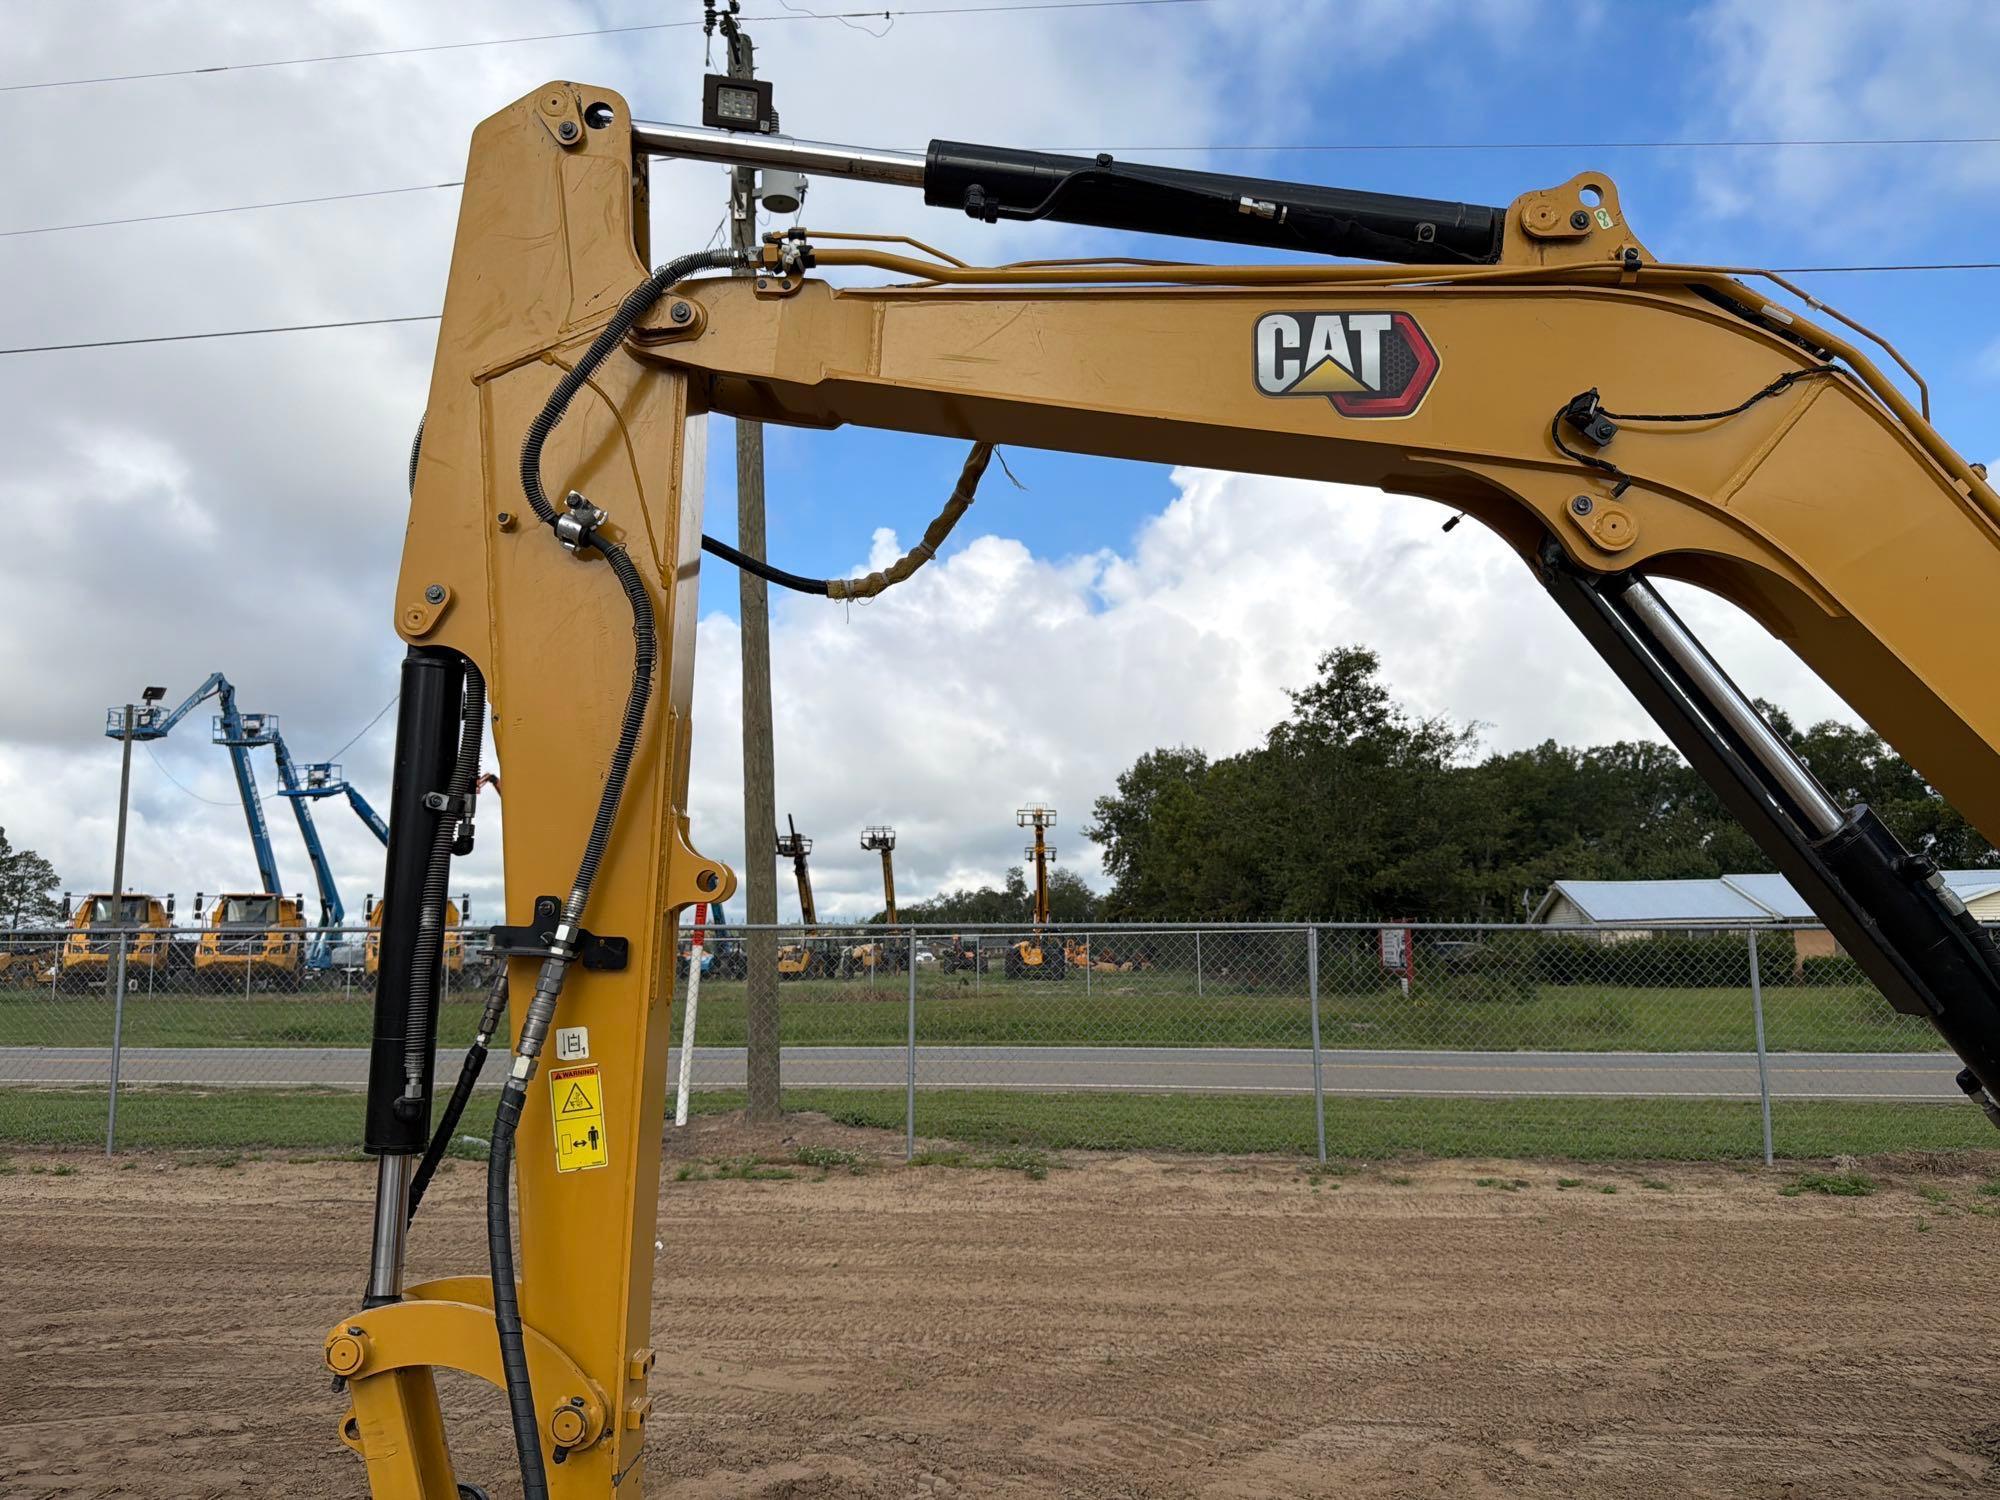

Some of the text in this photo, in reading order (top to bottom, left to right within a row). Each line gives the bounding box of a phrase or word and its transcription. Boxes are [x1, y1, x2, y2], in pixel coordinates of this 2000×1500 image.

[1257, 314, 1391, 392] CAT
[581, 1046, 586, 1055] 1
[562, 1067, 595, 1078] WARNING
